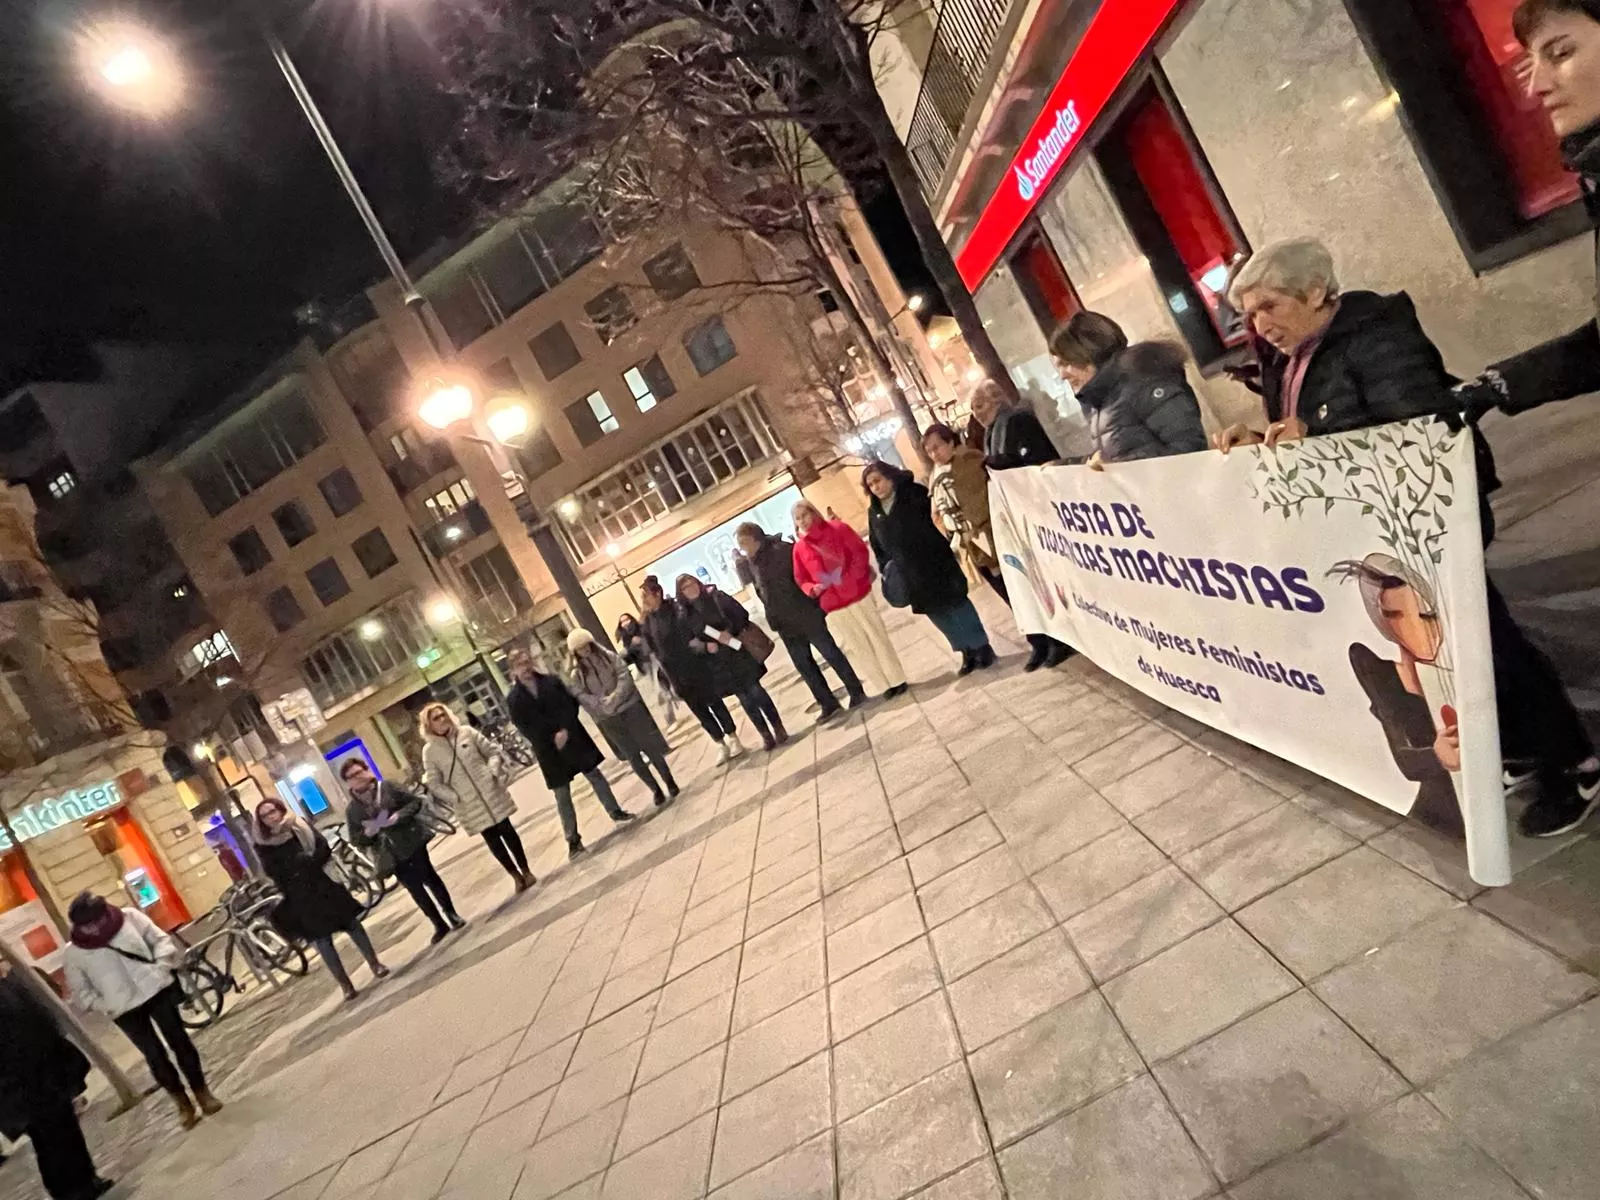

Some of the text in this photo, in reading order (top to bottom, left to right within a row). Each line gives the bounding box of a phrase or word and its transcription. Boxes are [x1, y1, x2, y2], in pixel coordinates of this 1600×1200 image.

[1024, 99, 1080, 188] Santander
[1110, 503, 1155, 539] DE
[1109, 547, 1325, 613] MACHISTAS
[1114, 611, 1130, 634] de
[1129, 617, 1196, 655] Mujeres
[1137, 655, 1222, 703] de Huesca
